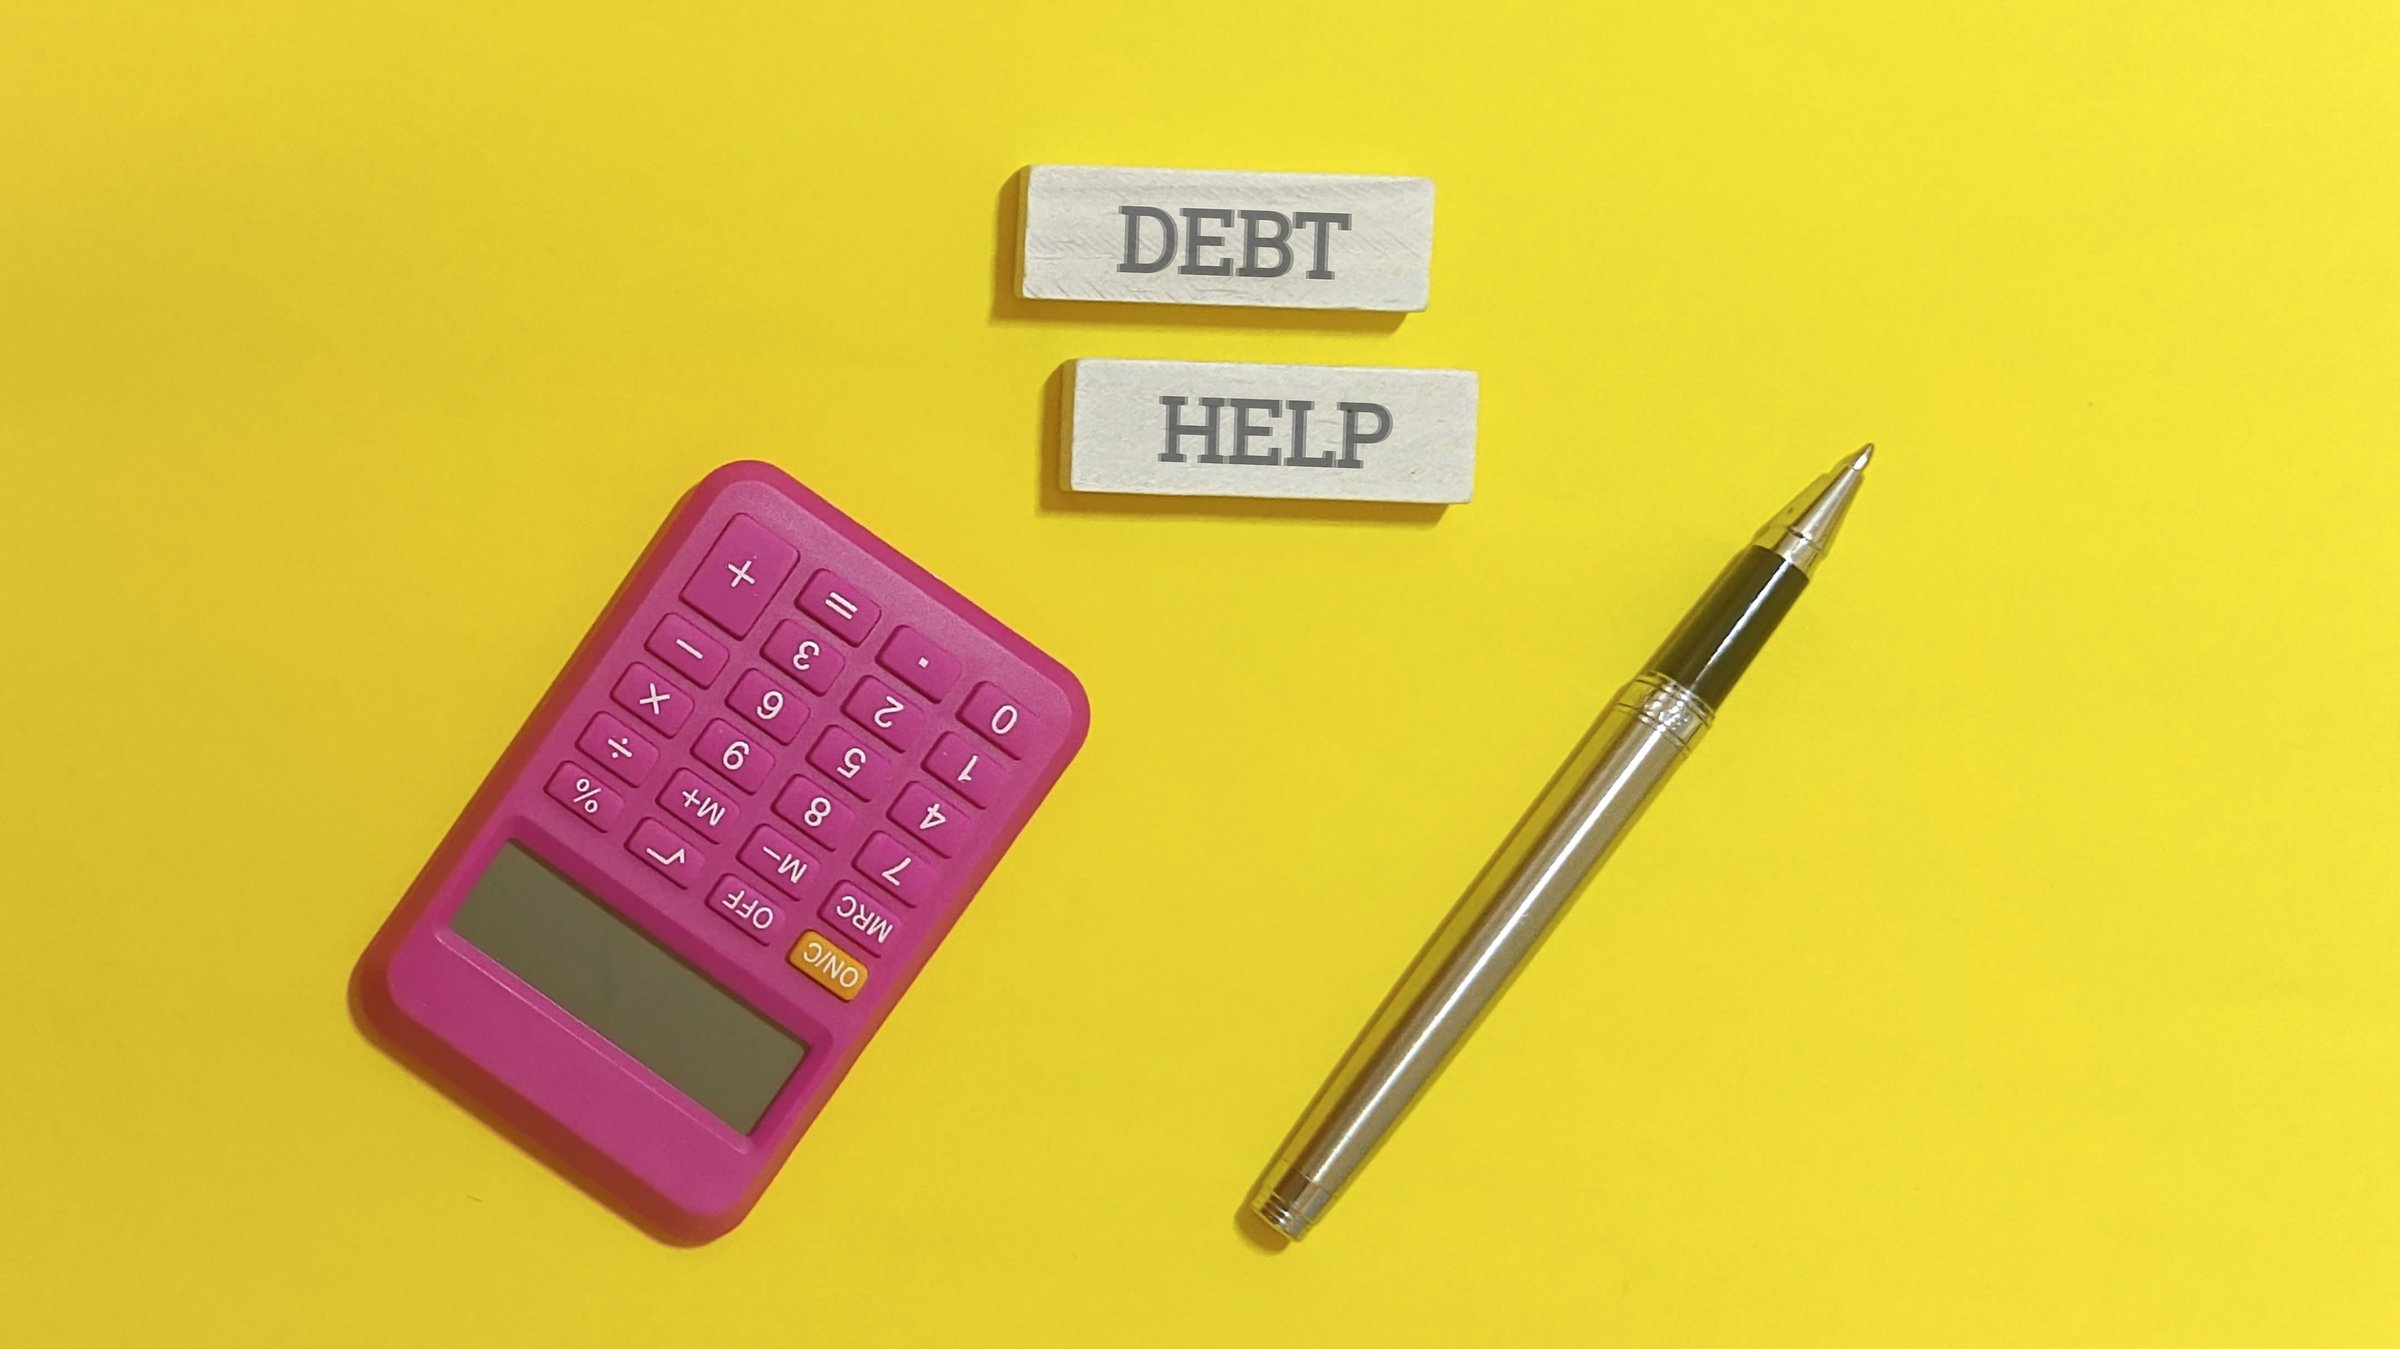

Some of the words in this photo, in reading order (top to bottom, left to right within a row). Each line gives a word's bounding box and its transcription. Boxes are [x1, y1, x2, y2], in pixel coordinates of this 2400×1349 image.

[793, 640, 820, 670] 3
[757, 690, 784, 720] 6
[874, 695, 904, 728] 2
[991, 705, 1018, 734] 0
[723, 741, 750, 770] 9
[837, 747, 866, 779] 5
[957, 755, 978, 781] 1
[573, 778, 602, 813] %
[682, 789, 726, 826] M+
[804, 797, 832, 827] 8
[919, 803, 946, 830] 4
[881, 857, 912, 886] 7
[722, 890, 774, 929] OFF
[836, 895, 893, 944] MRC
[803, 942, 863, 988] ON/C
